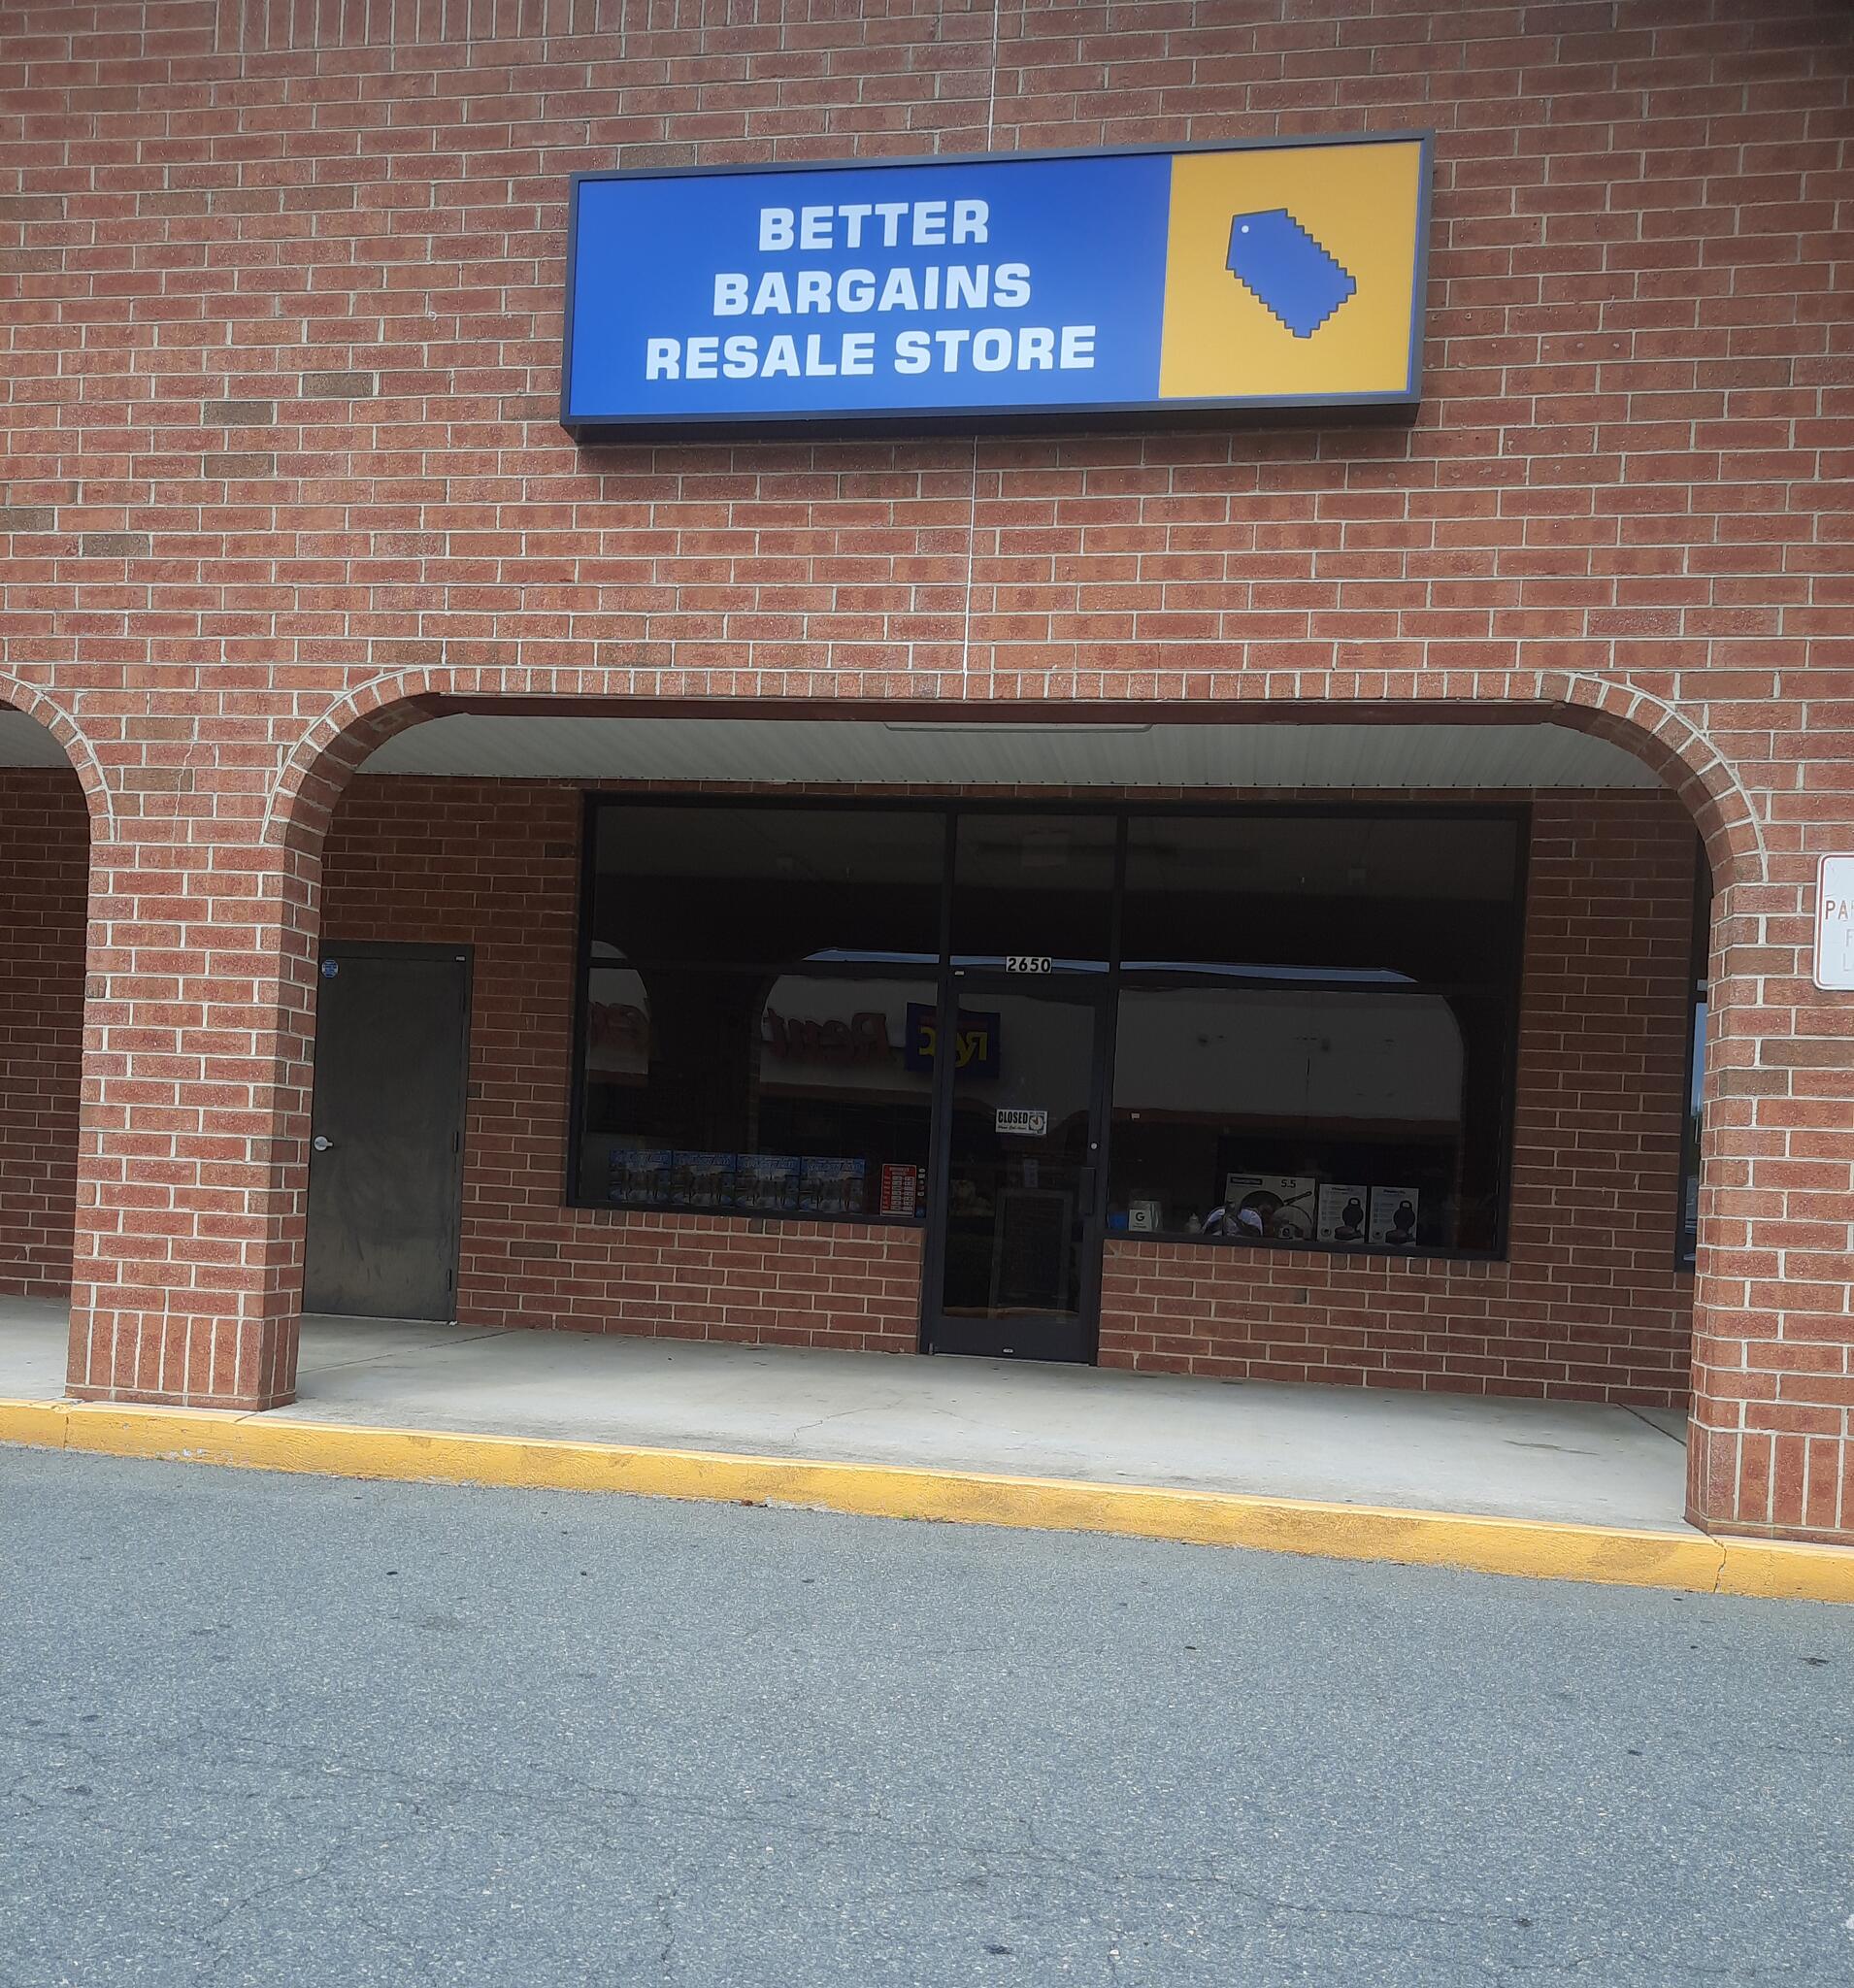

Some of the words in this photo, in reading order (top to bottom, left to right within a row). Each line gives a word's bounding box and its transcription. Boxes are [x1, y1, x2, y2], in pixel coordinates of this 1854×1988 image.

[758, 199, 990, 251] BETTER
[712, 263, 1032, 315] BARGAINS
[646, 332, 875, 381] RESALE
[893, 325, 1097, 375] STORE
[1007, 957, 1051, 972] 2650
[998, 1110, 1029, 1124] CLOSED
